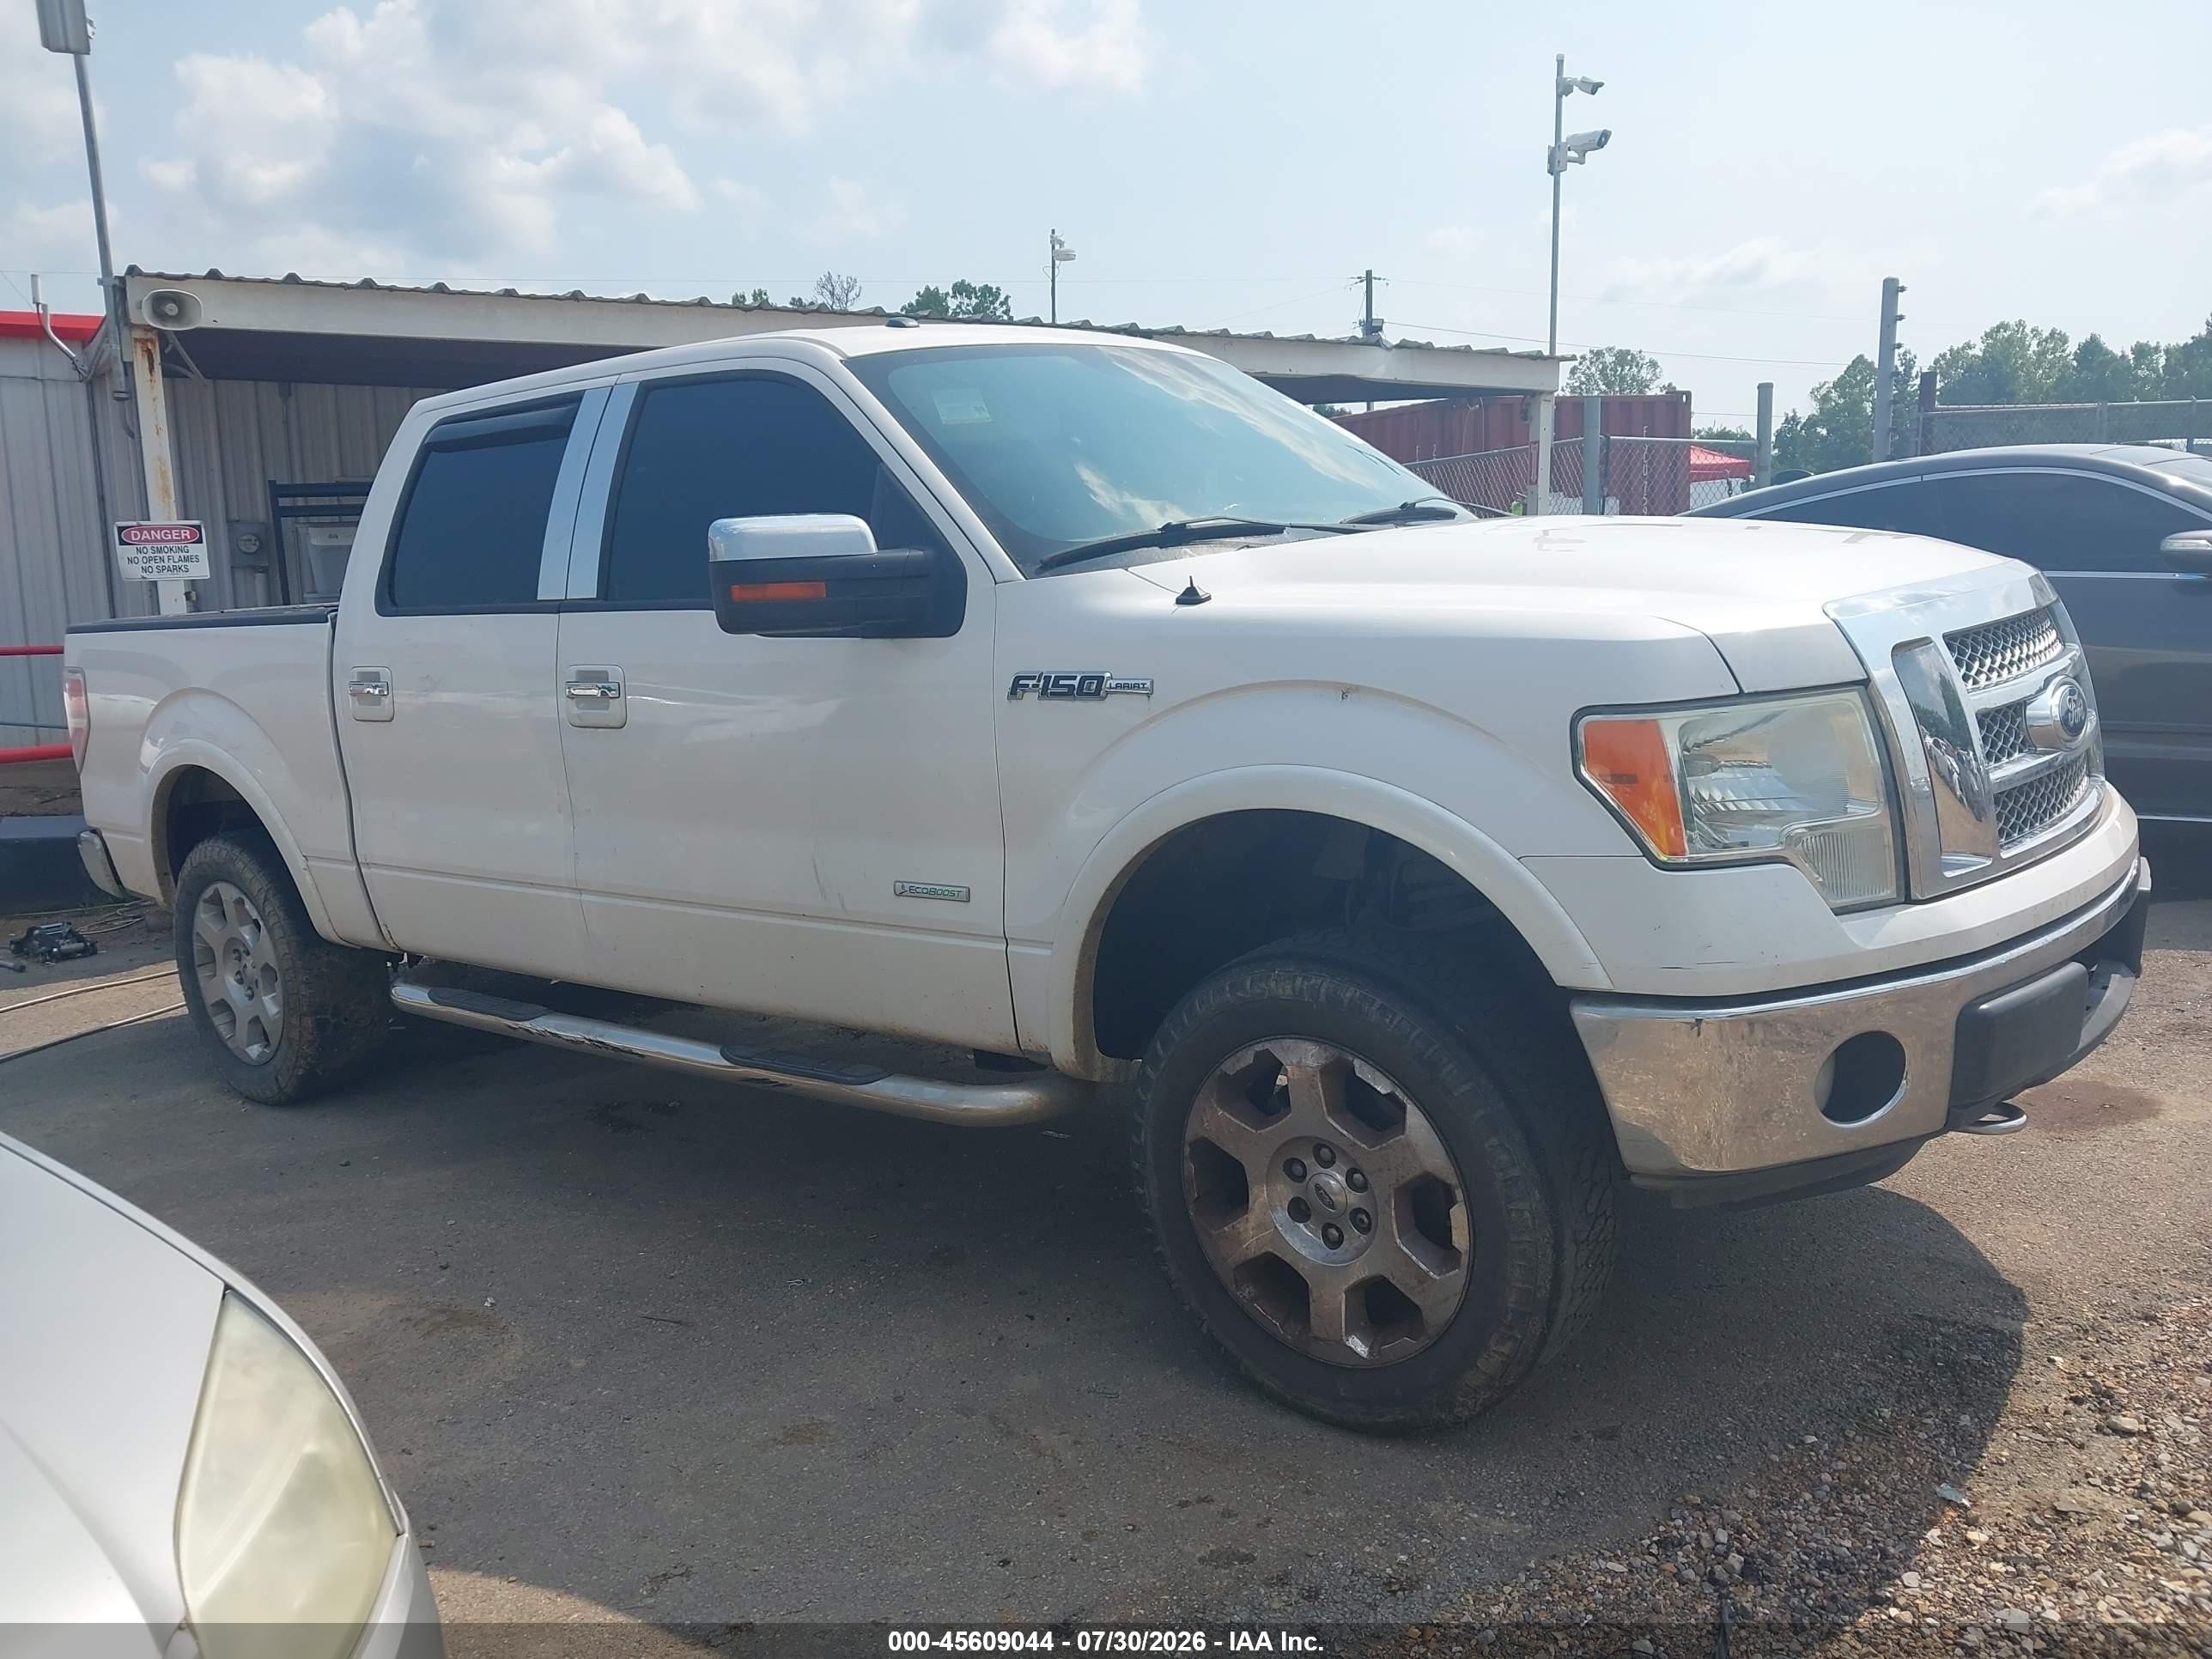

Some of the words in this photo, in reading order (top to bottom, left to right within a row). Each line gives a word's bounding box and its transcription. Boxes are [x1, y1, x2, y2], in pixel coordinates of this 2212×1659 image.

[131, 529, 191, 540] DANGER
[136, 546, 148, 555] NO
[150, 545, 190, 555] SMOKING
[142, 556, 165, 564] OPEN
[167, 555, 200, 563] FLAMES
[155, 564, 190, 574] SPARKS
[1008, 672, 1108, 700] F-150
[1109, 682, 1148, 690] LARIAT
[2066, 688, 2086, 727] Ford
